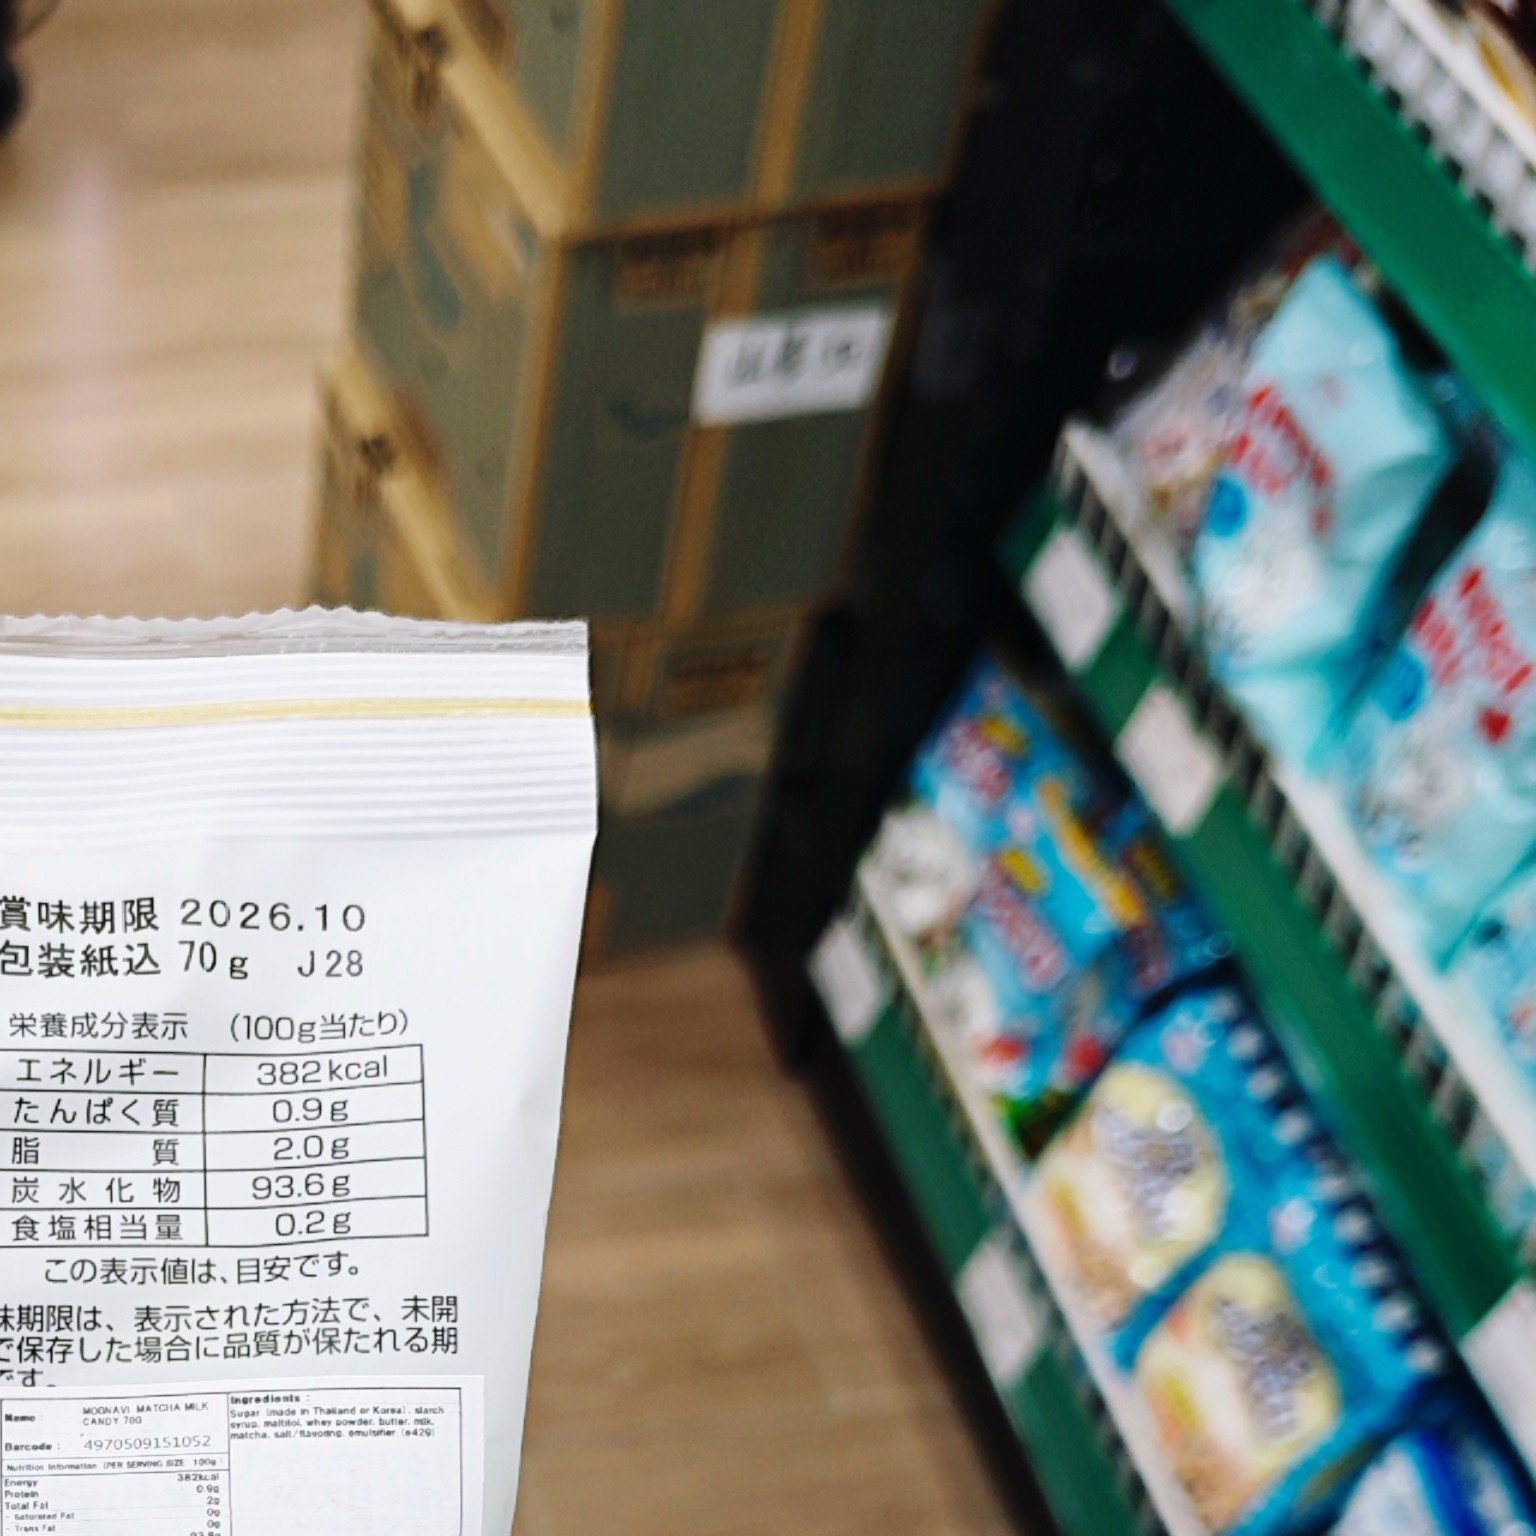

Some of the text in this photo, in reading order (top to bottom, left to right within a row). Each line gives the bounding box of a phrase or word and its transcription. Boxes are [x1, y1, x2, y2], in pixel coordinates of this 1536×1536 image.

[180, 899, 366, 932] 2026.10
[8, 1013, 187, 1040] 栄養成分表示
[15, 1054, 389, 1085] エネルギー 382kcal
[14, 1097, 349, 1127] たんぱく質 0.9g
[273, 1136, 350, 1163] 2.0g
[11, 1174, 351, 1203] 炭水化物 93.6g
[11, 1211, 351, 1242] 食塩相当量 0.2g
[44, 1252, 362, 1285] この表示値は、目安です。
[137, 1402, 208, 1413] MATCHA MILK
[231, 1409, 260, 1419] Sugar
[83, 1417, 118, 1426] CANDY
[5, 1443, 52, 1451] Barcode
[84, 1435, 211, 1450] 4970509151052
[48, 1462, 97, 1470] Information
[5, 1473, 219, 1488] Energy 382kcal
[5, 1490, 39, 1498] Protein
[5, 1502, 29, 1510] Total
[33, 1501, 49, 1510] Fat
